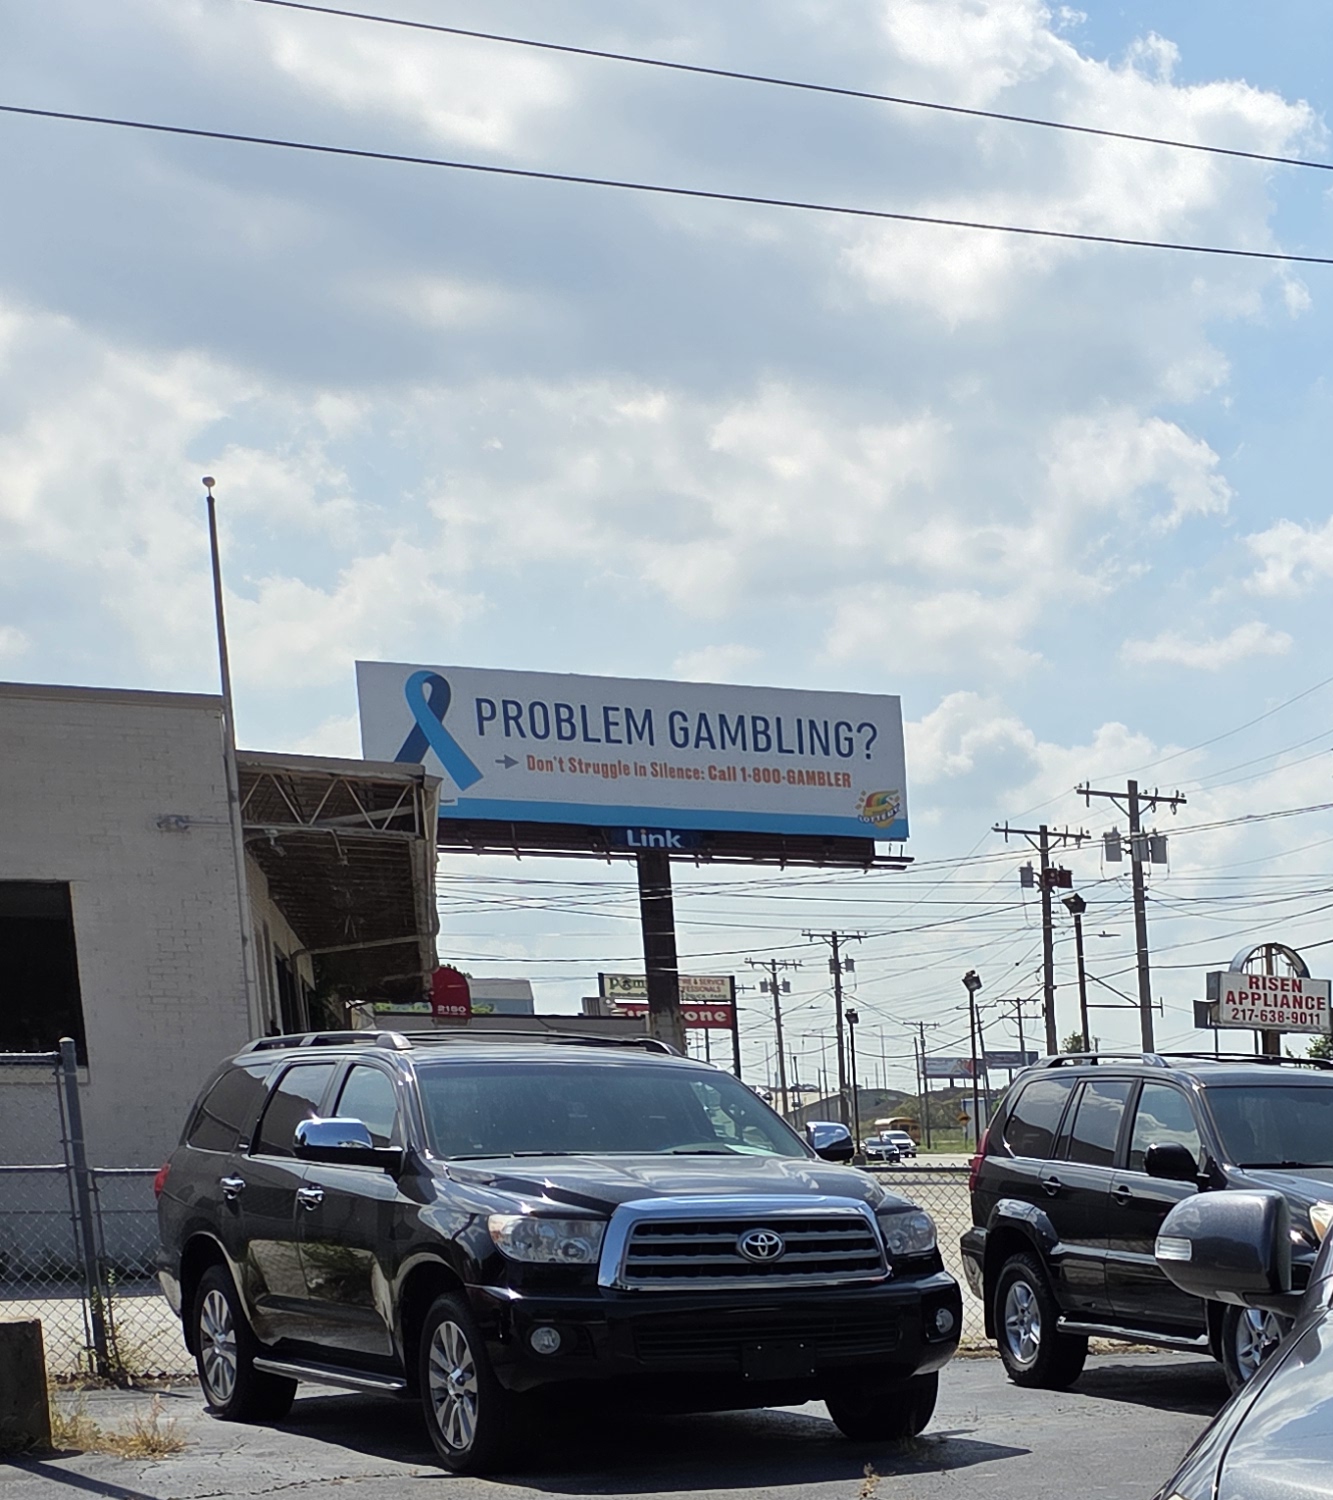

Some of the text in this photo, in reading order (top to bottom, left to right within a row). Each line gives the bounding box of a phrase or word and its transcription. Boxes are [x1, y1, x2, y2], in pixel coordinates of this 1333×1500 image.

[475, 697, 878, 760] PROBLEM GAMBLING?
[526, 754, 565, 773] Don't
[568, 757, 630, 780] Struggle
[650, 762, 705, 780] Silence:
[708, 764, 737, 782] Call
[740, 766, 852, 789] 1-800-GAMBLER
[626, 829, 682, 849] Link
[1248, 975, 1303, 993] RISEN
[1225, 990, 1326, 1011] APPLIANCE
[1231, 1007, 1321, 1026] 217-638-9011
